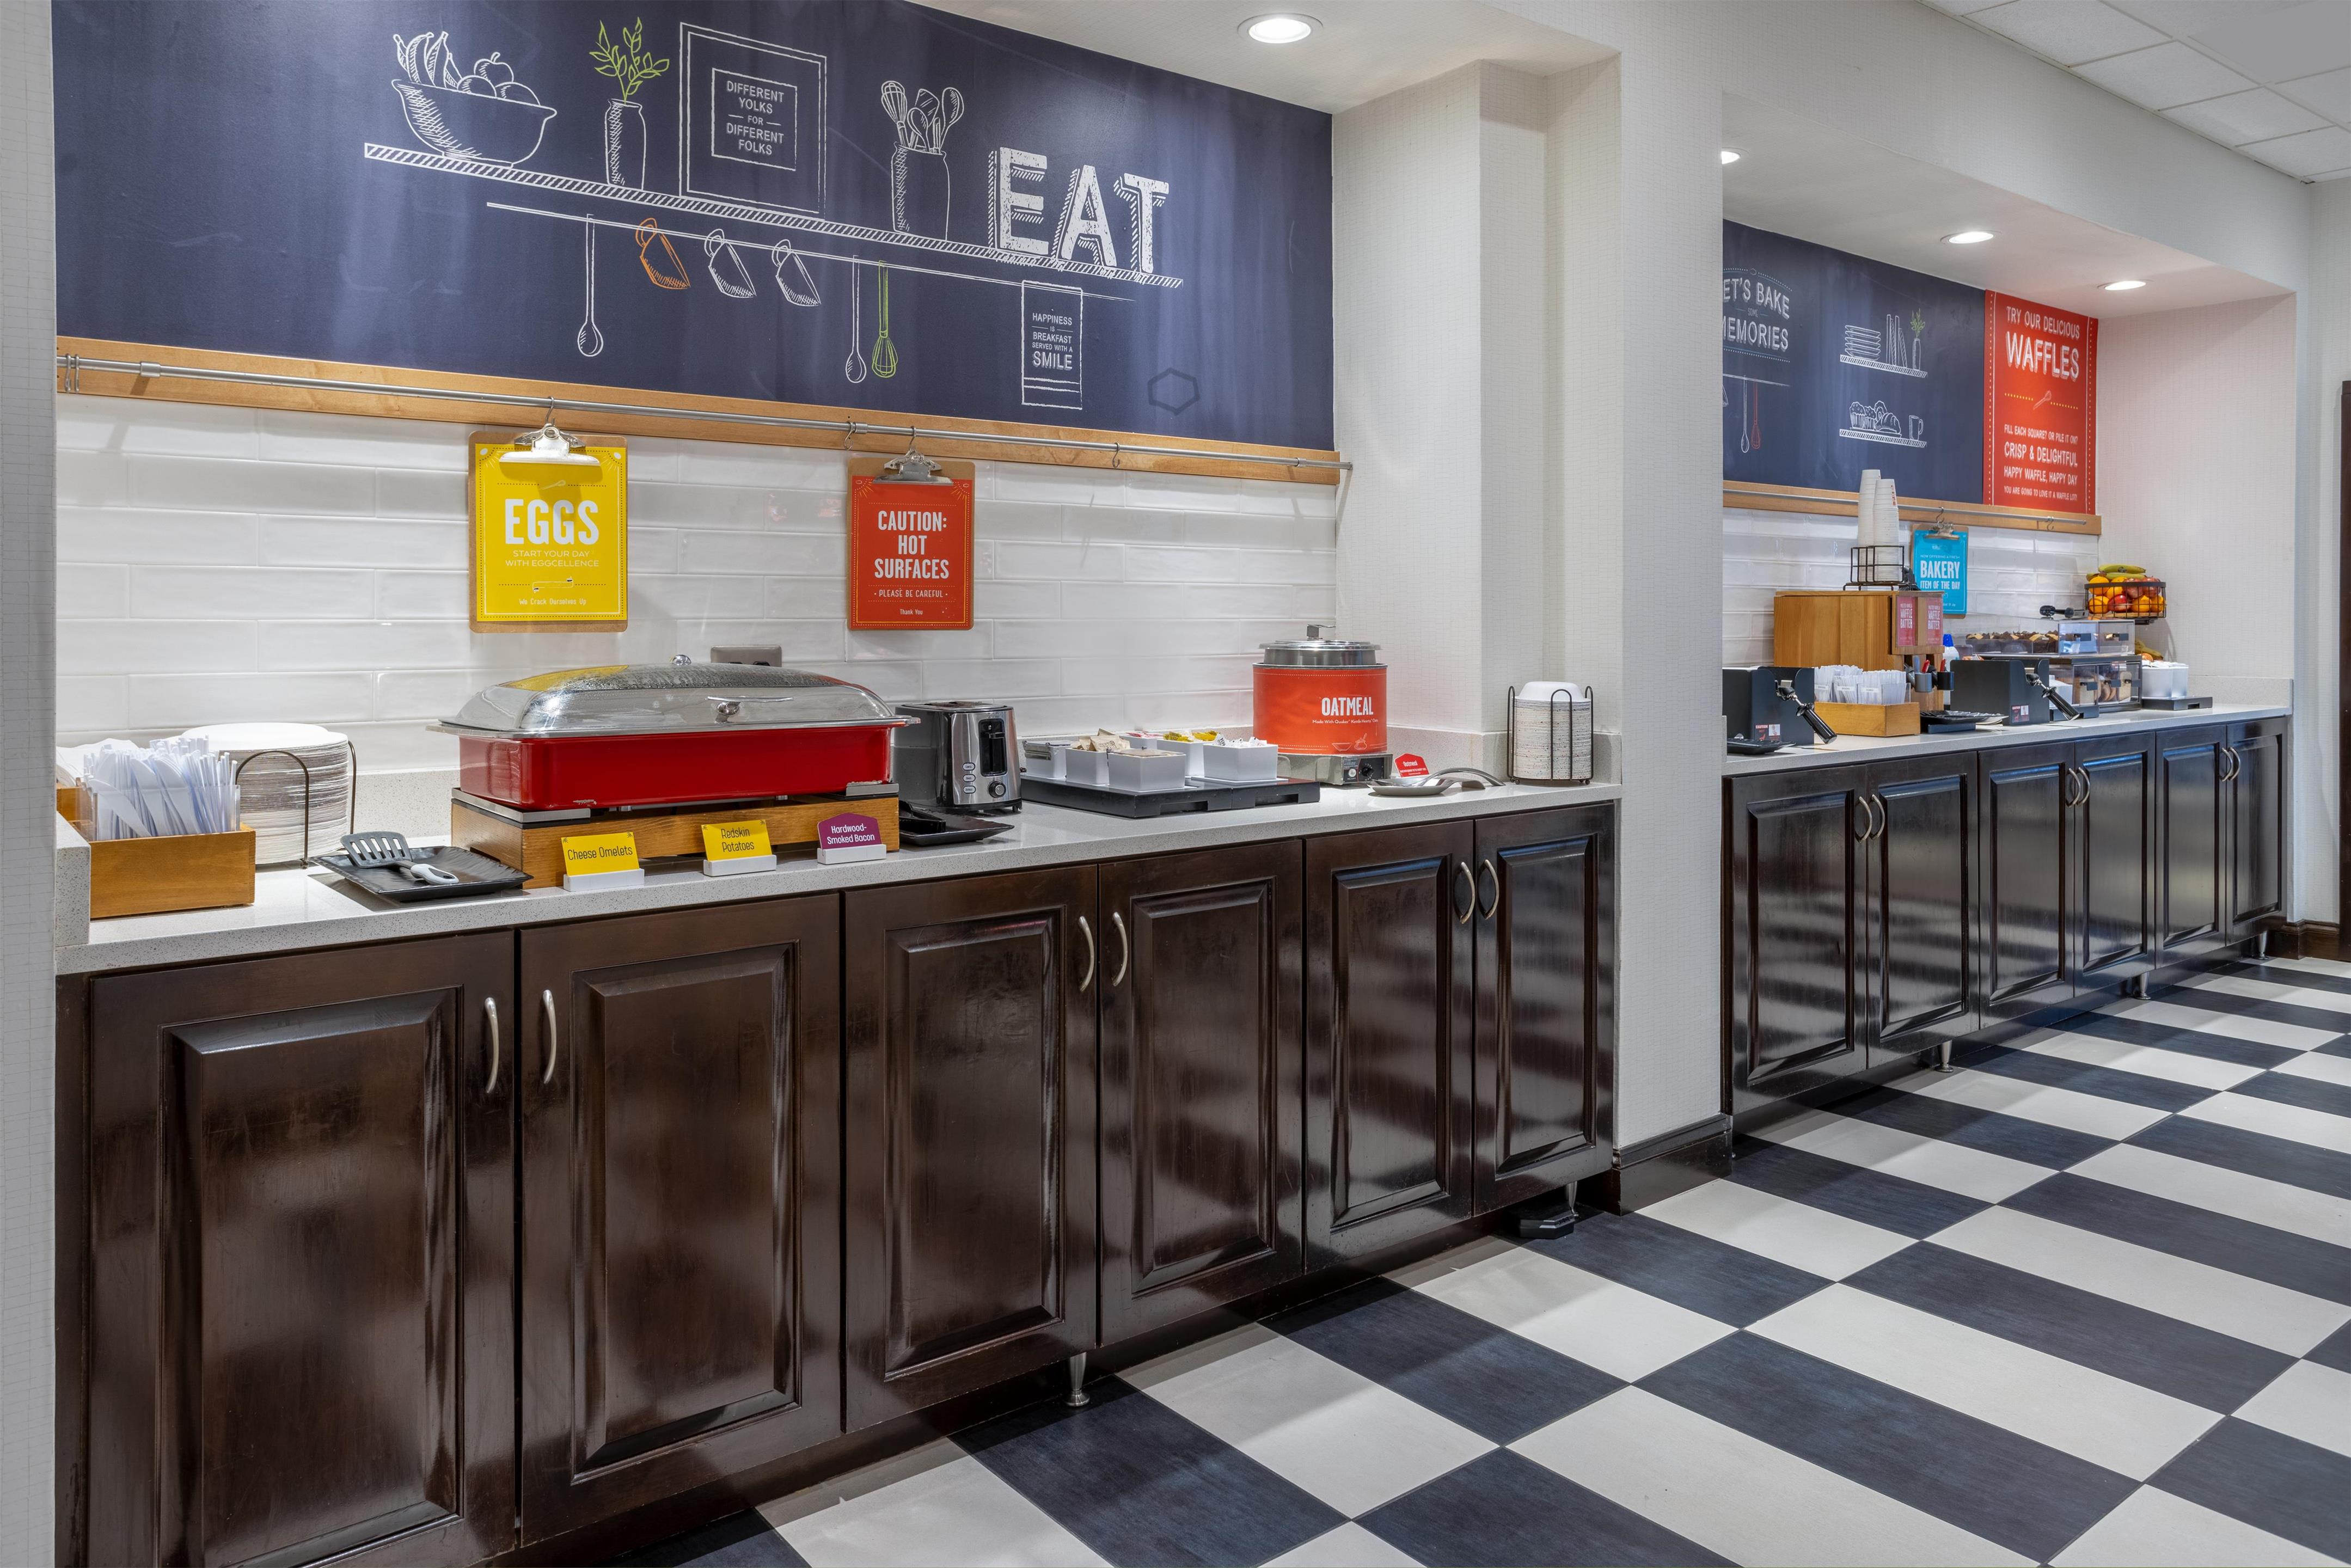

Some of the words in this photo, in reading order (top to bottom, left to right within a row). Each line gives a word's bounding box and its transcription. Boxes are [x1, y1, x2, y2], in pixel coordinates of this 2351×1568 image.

[726, 80, 784, 102] DIFFERENT
[739, 97, 773, 114] YOLKS
[748, 115, 763, 126] FOR
[726, 122, 784, 144] DIFFERENT
[738, 139, 772, 155] FOLKS
[988, 147, 1170, 274] EAT
[1723, 278, 1751, 303] ET'S
[1756, 282, 1790, 320] BAKE
[1032, 313, 1072, 326] HAPPINESS
[1747, 308, 1759, 317] SOME
[2007, 306, 2022, 324] TRY
[2024, 310, 2041, 330] OUR
[2043, 316, 2080, 340] DELICIOUS
[1032, 342, 1052, 350] SERVED
[1033, 332, 1072, 344] BREAKFAST
[1032, 351, 1073, 370] SMILE
[2006, 331, 2079, 382] WAFFLES
[2004, 424, 2013, 434] FILL
[2015, 426, 2026, 436] EACH
[2028, 428, 2047, 440] SQUARE?
[2048, 431, 2055, 441] OR
[2056, 433, 2064, 443] PILE
[2065, 434, 2069, 443] IT
[2070, 435, 2078, 444] ON?
[2004, 442, 2027, 460] CRISP
[2029, 445, 2035, 461] &
[2037, 446, 2078, 468] DELIGHTFUL
[2004, 466, 2023, 479] HAPPY
[2024, 468, 2047, 483] WAFFLE,
[2049, 471, 2066, 484] HAPPY
[2067, 474, 2078, 486] DAY
[2004, 486, 2012, 494] YOU
[2012, 487, 2021, 495] ARE
[2021, 487, 2032, 496] GOING
[2034, 489, 2038, 497] TO
[2056, 492, 2070, 501] WAFFLE
[505, 499, 600, 545] EGGS
[878, 511, 947, 532] CAUTION:
[898, 535, 928, 555] HOT
[874, 558, 950, 580] SURFACES
[1920, 560, 1960, 579] BAKERY
[1920, 580, 1932, 589] ITEM
[1933, 581, 1939, 589] OF
[1940, 581, 1950, 589] THE
[1951, 581, 1960, 590] DAY
[879, 589, 903, 597] PLEASE
[905, 590, 914, 598] BE
[915, 590, 944, 598] CAREFUL
[1901, 608, 1913, 618] WAFFLE
[1928, 610, 1940, 620] WAFFLE
[1900, 618, 1913, 629] BATTER
[1928, 620, 1940, 630] BATTER
[1321, 697, 1374, 716] OATMEAL
[721, 826, 750, 839] Redskin
[831, 823, 867, 834] Hardwood-
[827, 835, 854, 844] Smoked
[854, 834, 875, 842] Bacon
[567, 849, 597, 860] Cheese
[598, 846, 633, 858] Omelets
[722, 842, 755, 853] Potatoes
